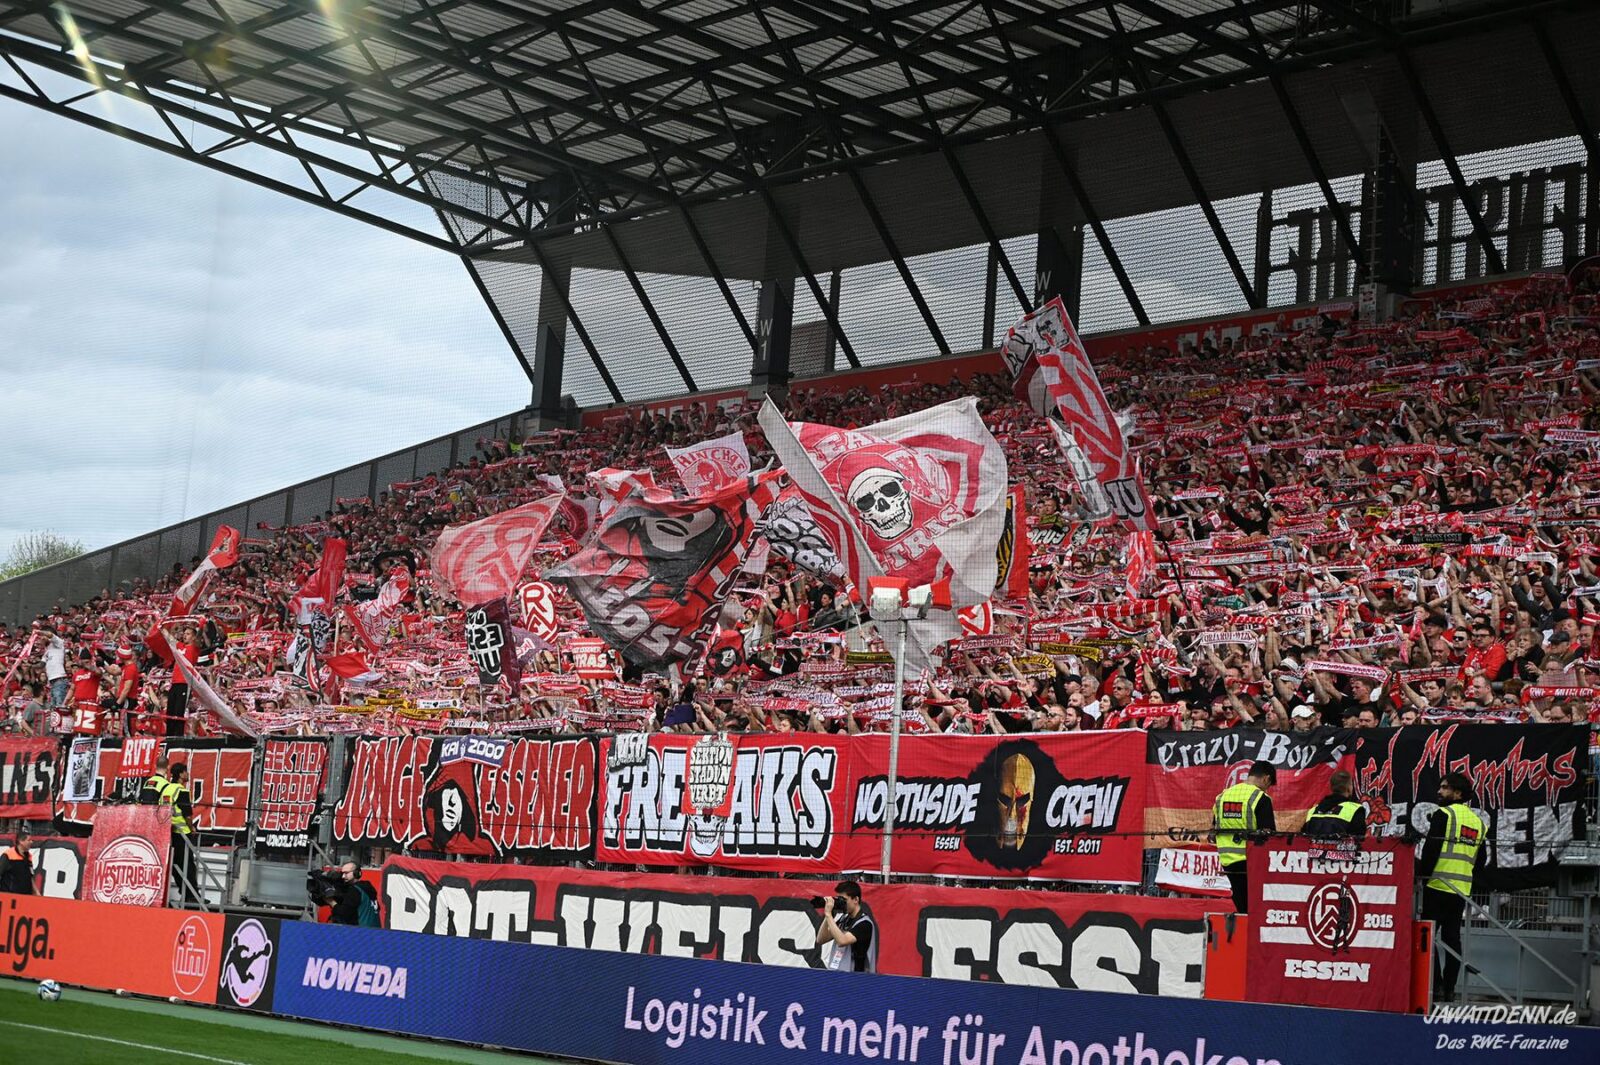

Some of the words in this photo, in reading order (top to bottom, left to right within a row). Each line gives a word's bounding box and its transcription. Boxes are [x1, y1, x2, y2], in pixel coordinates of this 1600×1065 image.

[1036, 270, 1051, 291] W
[122, 738, 157, 766] RVT
[467, 738, 505, 759] 2000
[0, 750, 54, 805] NS
[1046, 782, 1123, 828] CREW
[934, 836, 960, 850] ESSEN
[1055, 839, 1075, 853] EST.
[1077, 840, 1101, 854] 2011
[1172, 852, 1189, 872] LA
[1193, 854, 1227, 878] BAN
[1265, 909, 1300, 925] SEIT
[1363, 913, 1394, 929] 2015
[302, 957, 408, 999] NOWEDA
[1284, 958, 1371, 983] ESSEN
[624, 986, 769, 1048] Logistik
[779, 1002, 807, 1050] &
[821, 1009, 929, 1062] mehr
[942, 1014, 1006, 1065] für
